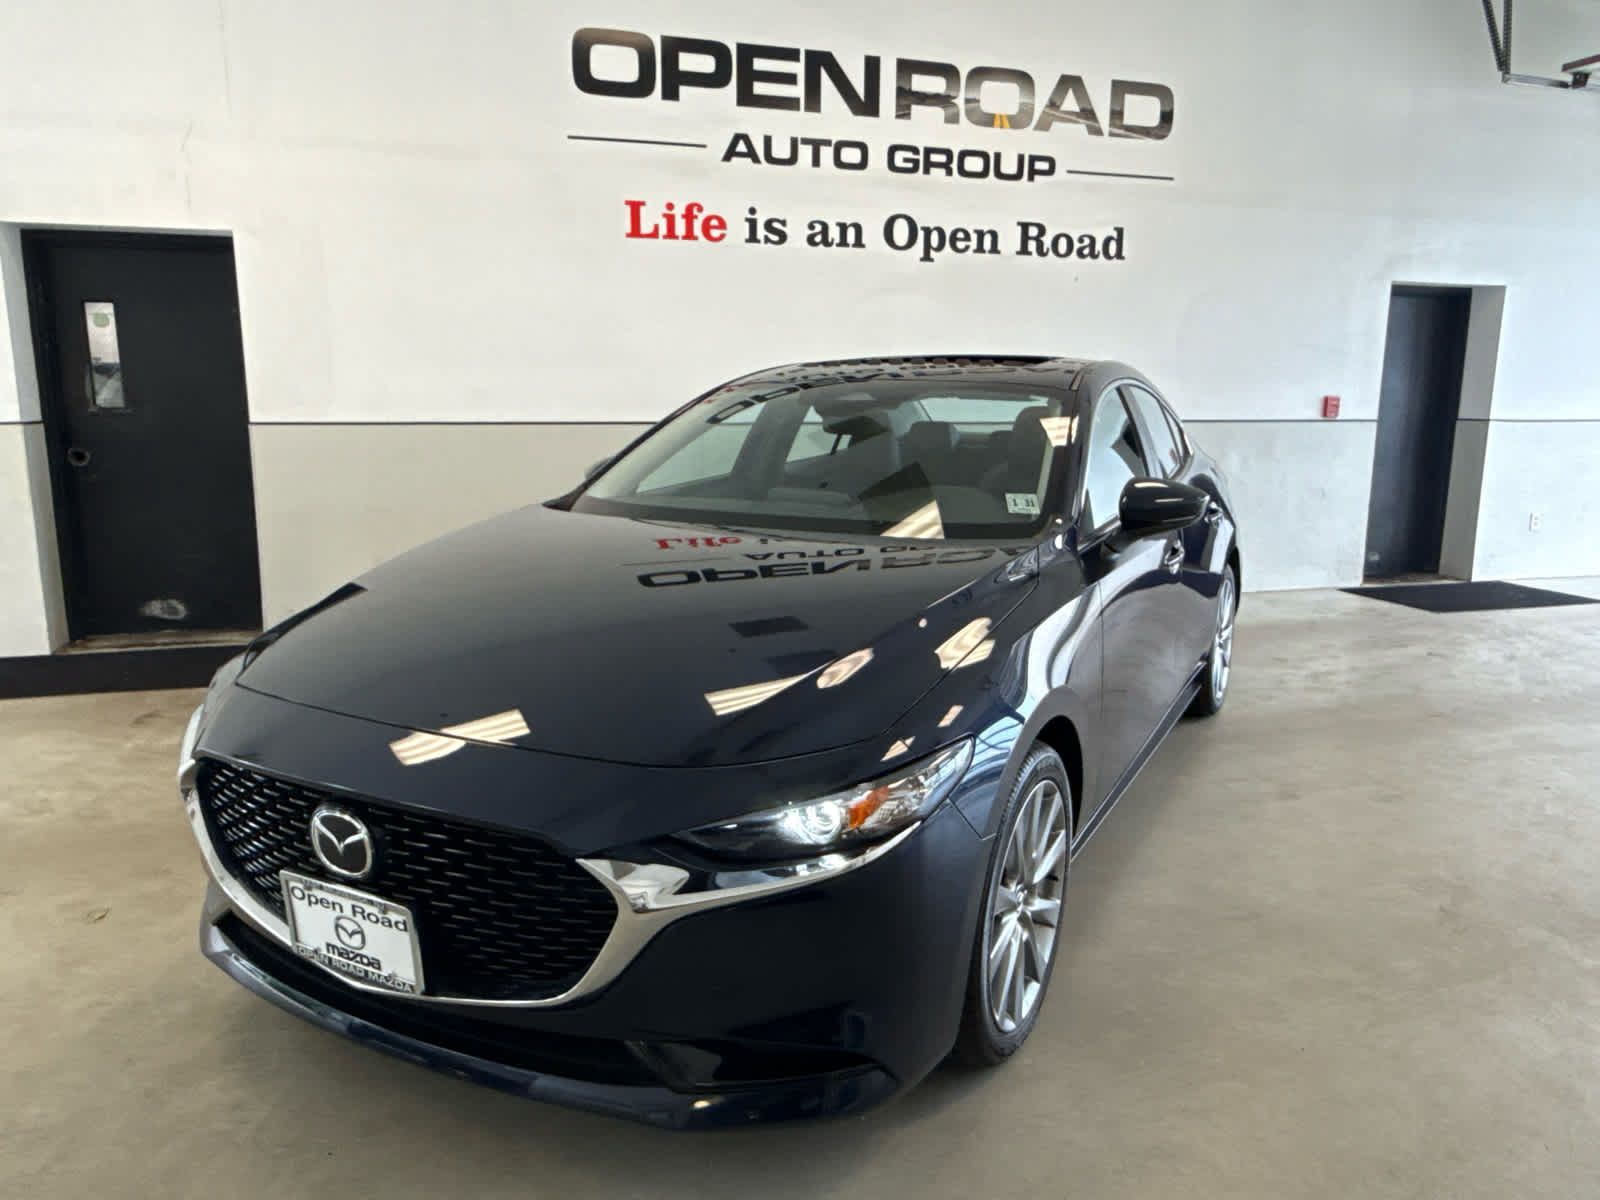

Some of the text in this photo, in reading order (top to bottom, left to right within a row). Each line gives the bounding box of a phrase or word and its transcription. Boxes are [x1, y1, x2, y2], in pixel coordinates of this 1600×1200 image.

[571, 27, 1175, 141] OPEN ROAD
[721, 132, 1057, 183] AUTO GROUP
[624, 200, 1126, 262] Life is an Open Road
[290, 885, 408, 932] Open Road
[325, 942, 382, 971] mazda
[332, 959, 366, 978] ROAD
[367, 969, 413, 993] MAZDA
